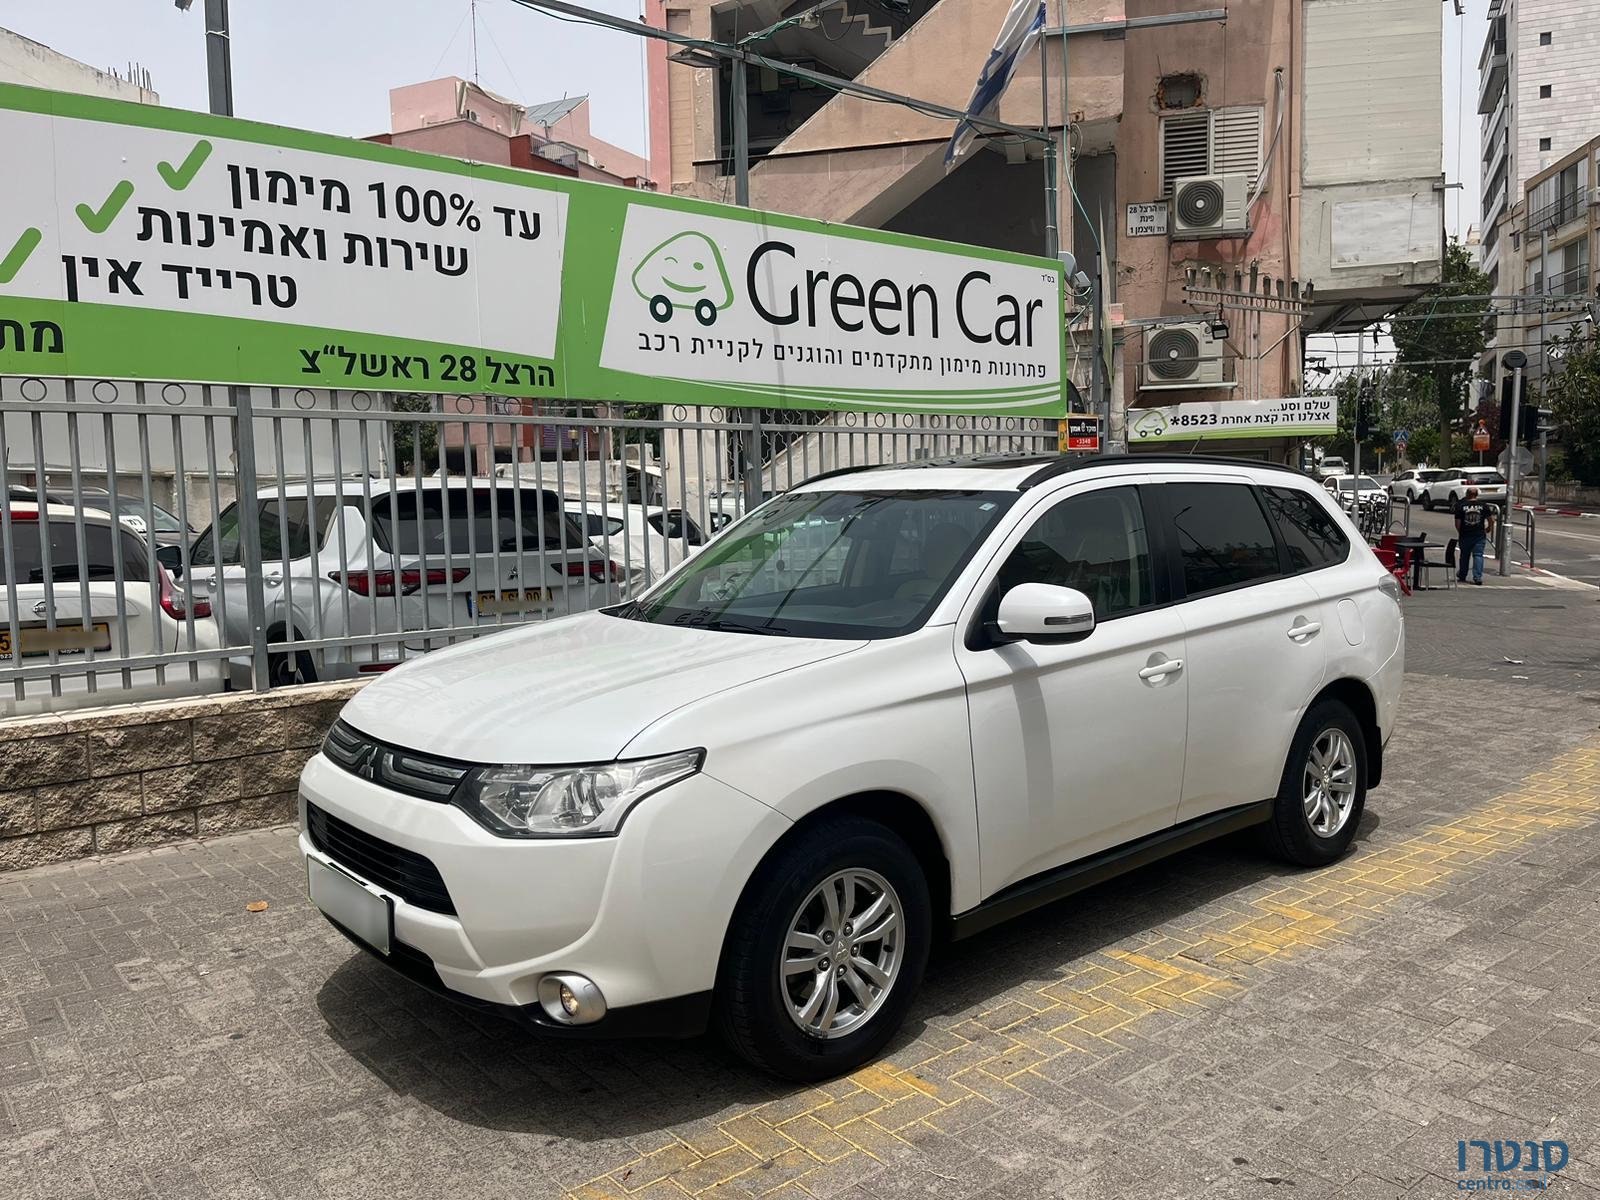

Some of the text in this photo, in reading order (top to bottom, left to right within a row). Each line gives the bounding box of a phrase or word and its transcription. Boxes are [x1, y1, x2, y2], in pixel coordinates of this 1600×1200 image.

[227, 164, 541, 240] עד 100% מימון
[1139, 205, 1157, 213] הרצל
[1136, 225, 1152, 234] ויצמן
[136, 206, 468, 277] שירות ואמינות
[61, 254, 298, 309] טרייד אין
[746, 240, 1043, 349] Green Car
[638, 332, 1047, 379] פתרונות מימון מתקדמים והוגנים לקניית רכב
[439, 354, 478, 383] 28
[484, 355, 556, 388] הרצל
[1269, 400, 1330, 412] שלם וסע...
[1298, 410, 1330, 422] אצלנו
[1220, 414, 1252, 425] אחרת
[1253, 413, 1279, 425] קצת
[1282, 413, 1295, 422] זה
